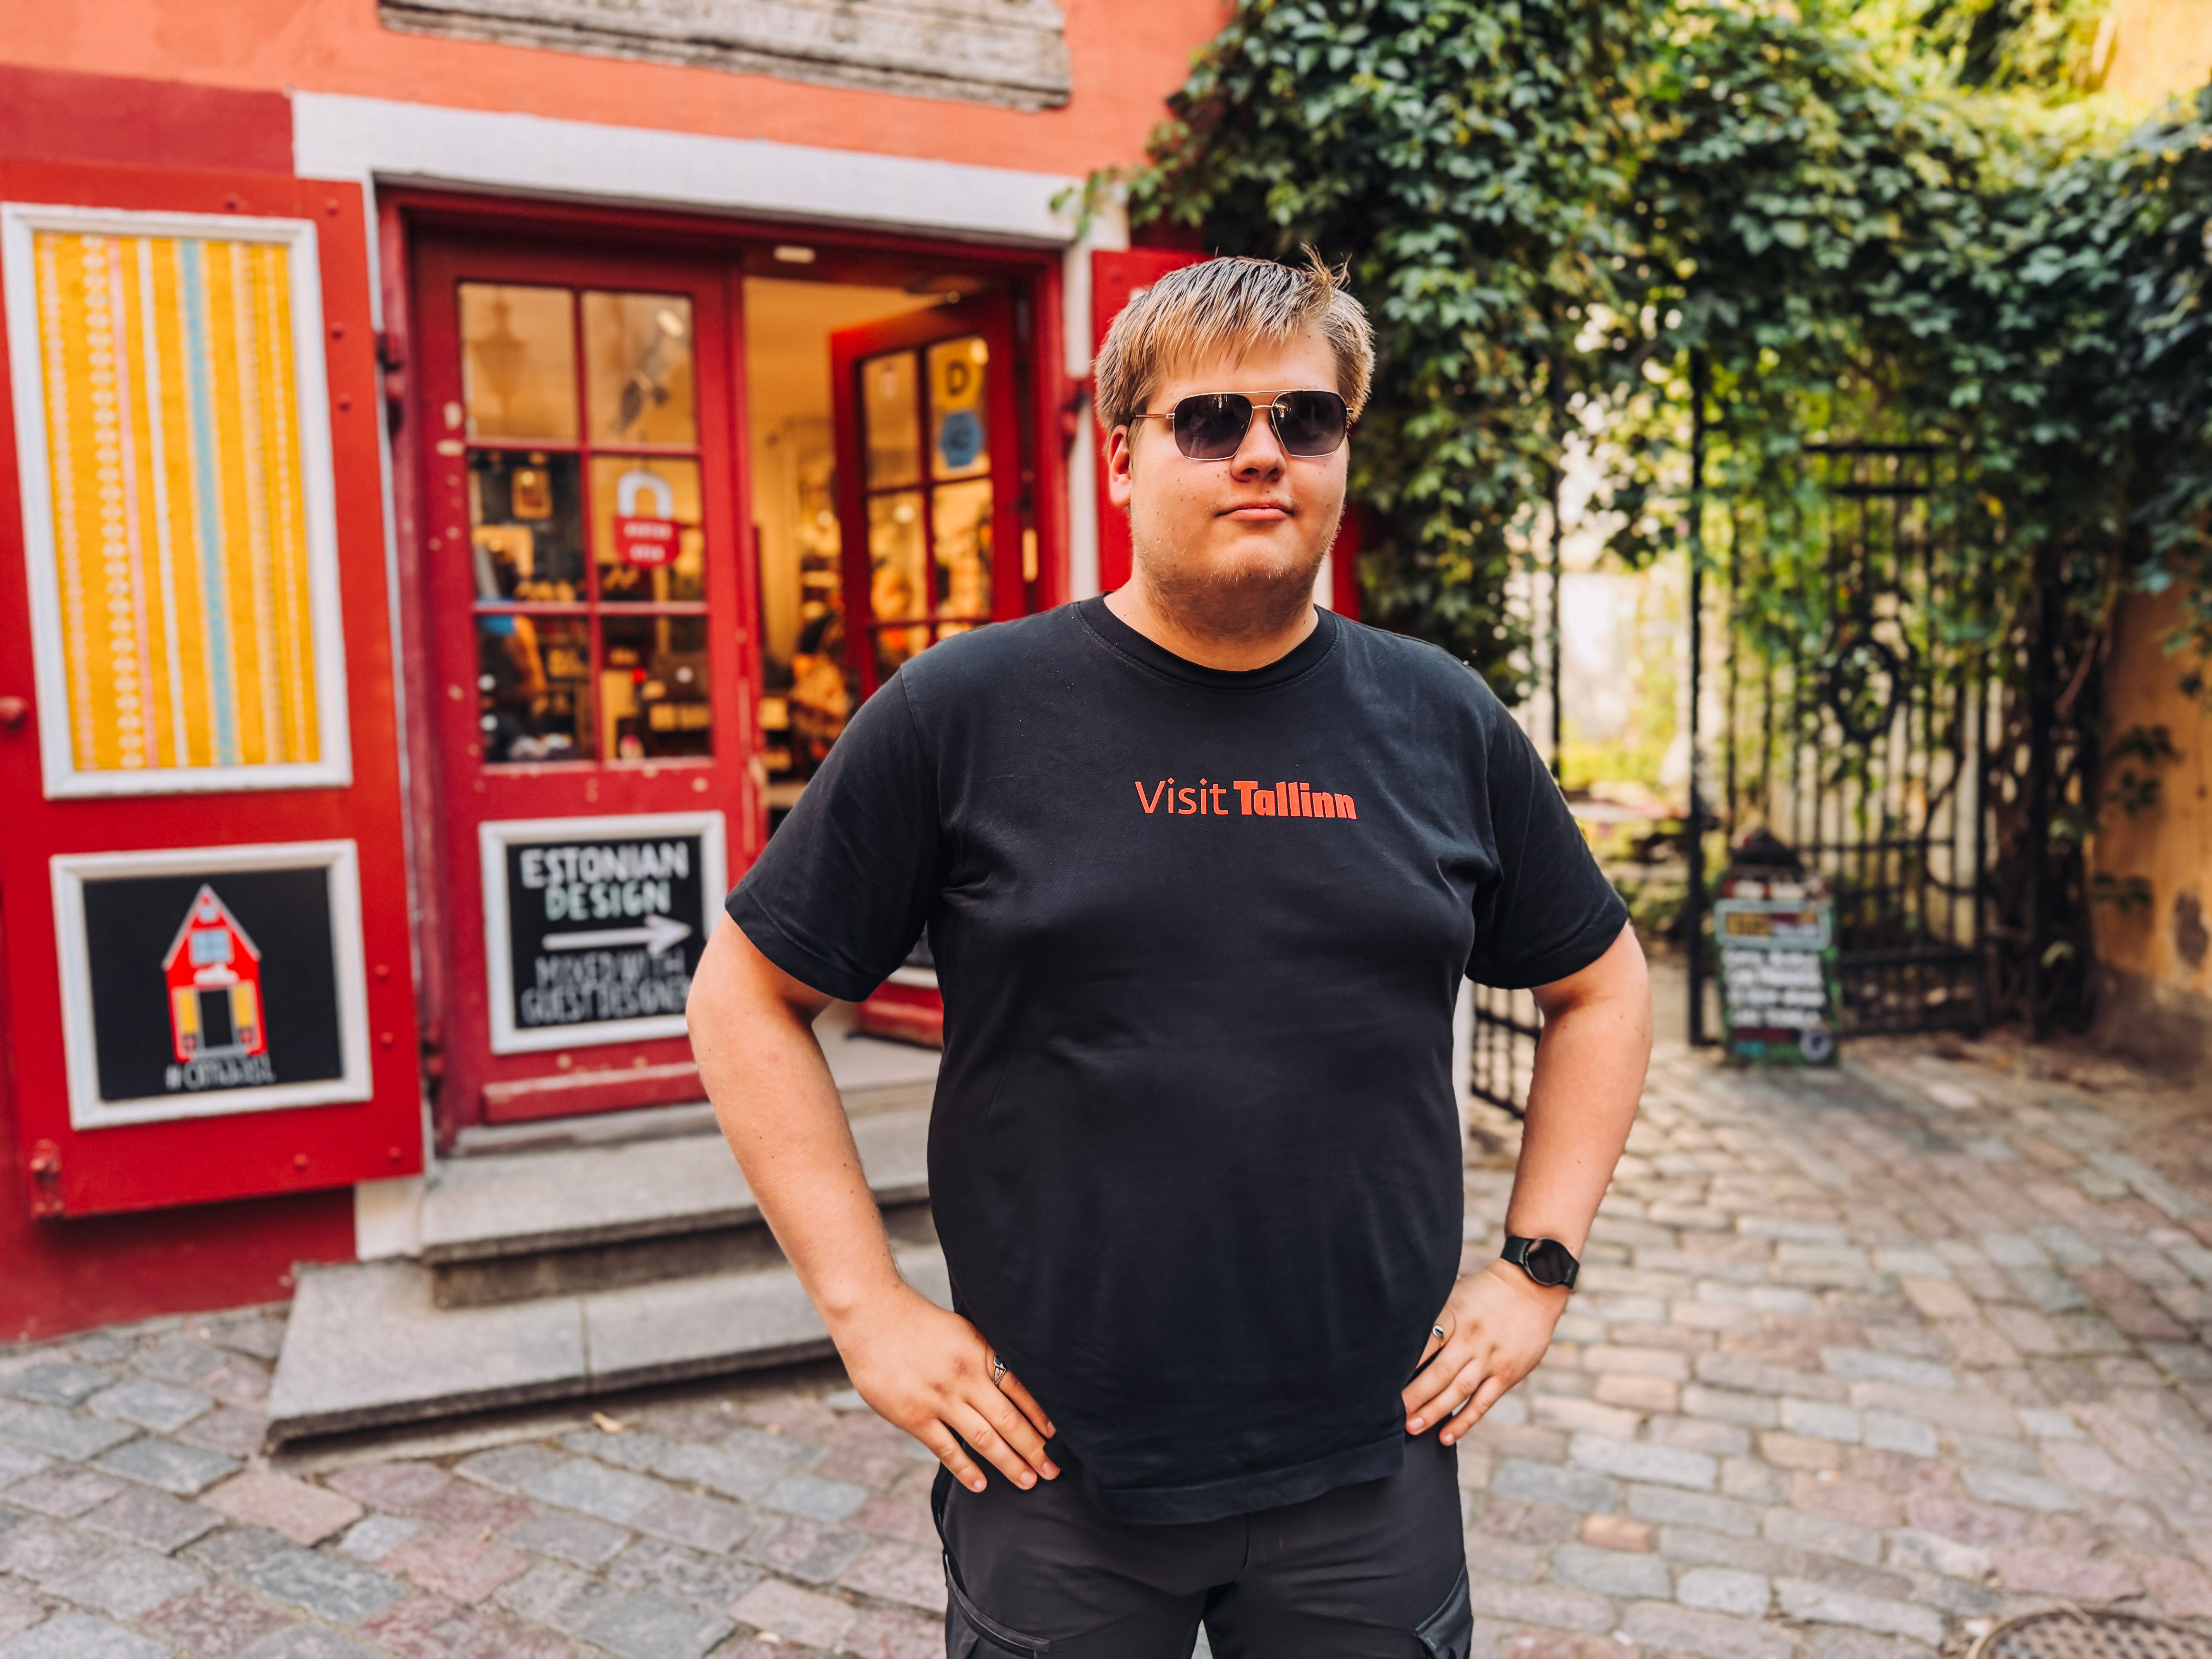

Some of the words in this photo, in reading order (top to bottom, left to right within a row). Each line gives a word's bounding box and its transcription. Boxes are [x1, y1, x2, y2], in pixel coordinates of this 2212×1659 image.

[1135, 777, 1228, 815] Visit
[1233, 780, 1357, 819] Tallinn
[521, 842, 689, 888] ESTONIAN
[546, 879, 671, 921] DESIGN
